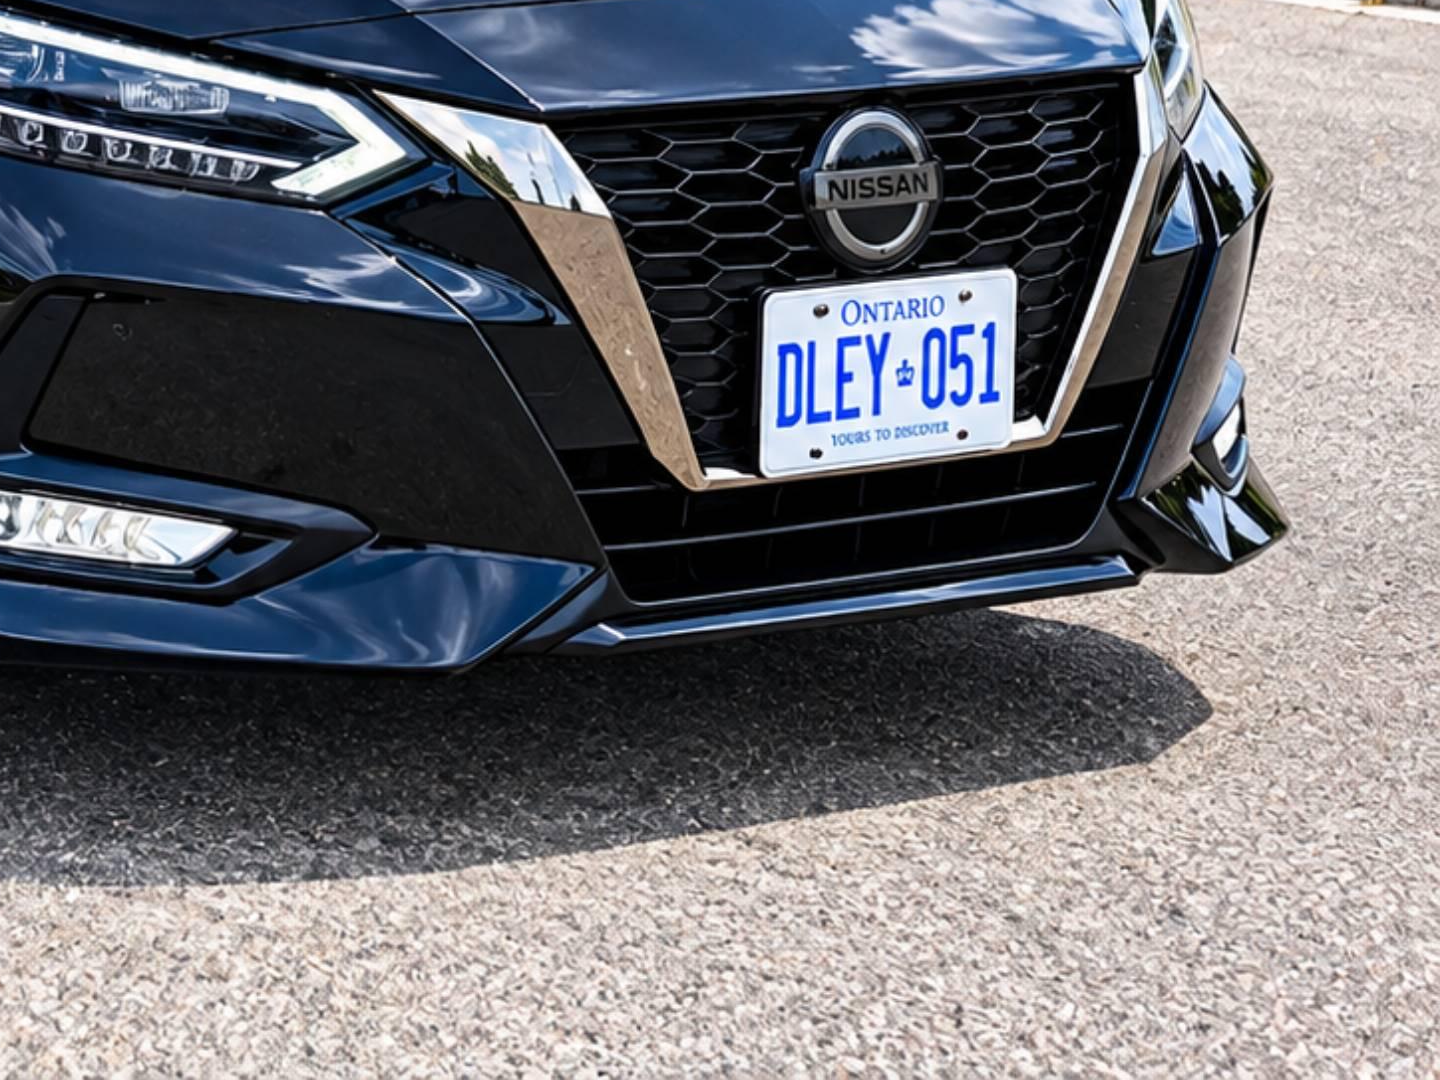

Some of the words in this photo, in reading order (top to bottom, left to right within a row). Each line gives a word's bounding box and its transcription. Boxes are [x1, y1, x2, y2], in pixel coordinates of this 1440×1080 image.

[827, 172, 929, 202] NISSAN
[840, 295, 945, 327] ONTARIO
[775, 331, 892, 428] DLEY
[921, 322, 1000, 410] 051
[875, 427, 892, 441] TO
[894, 421, 950, 439] DISCOVER
